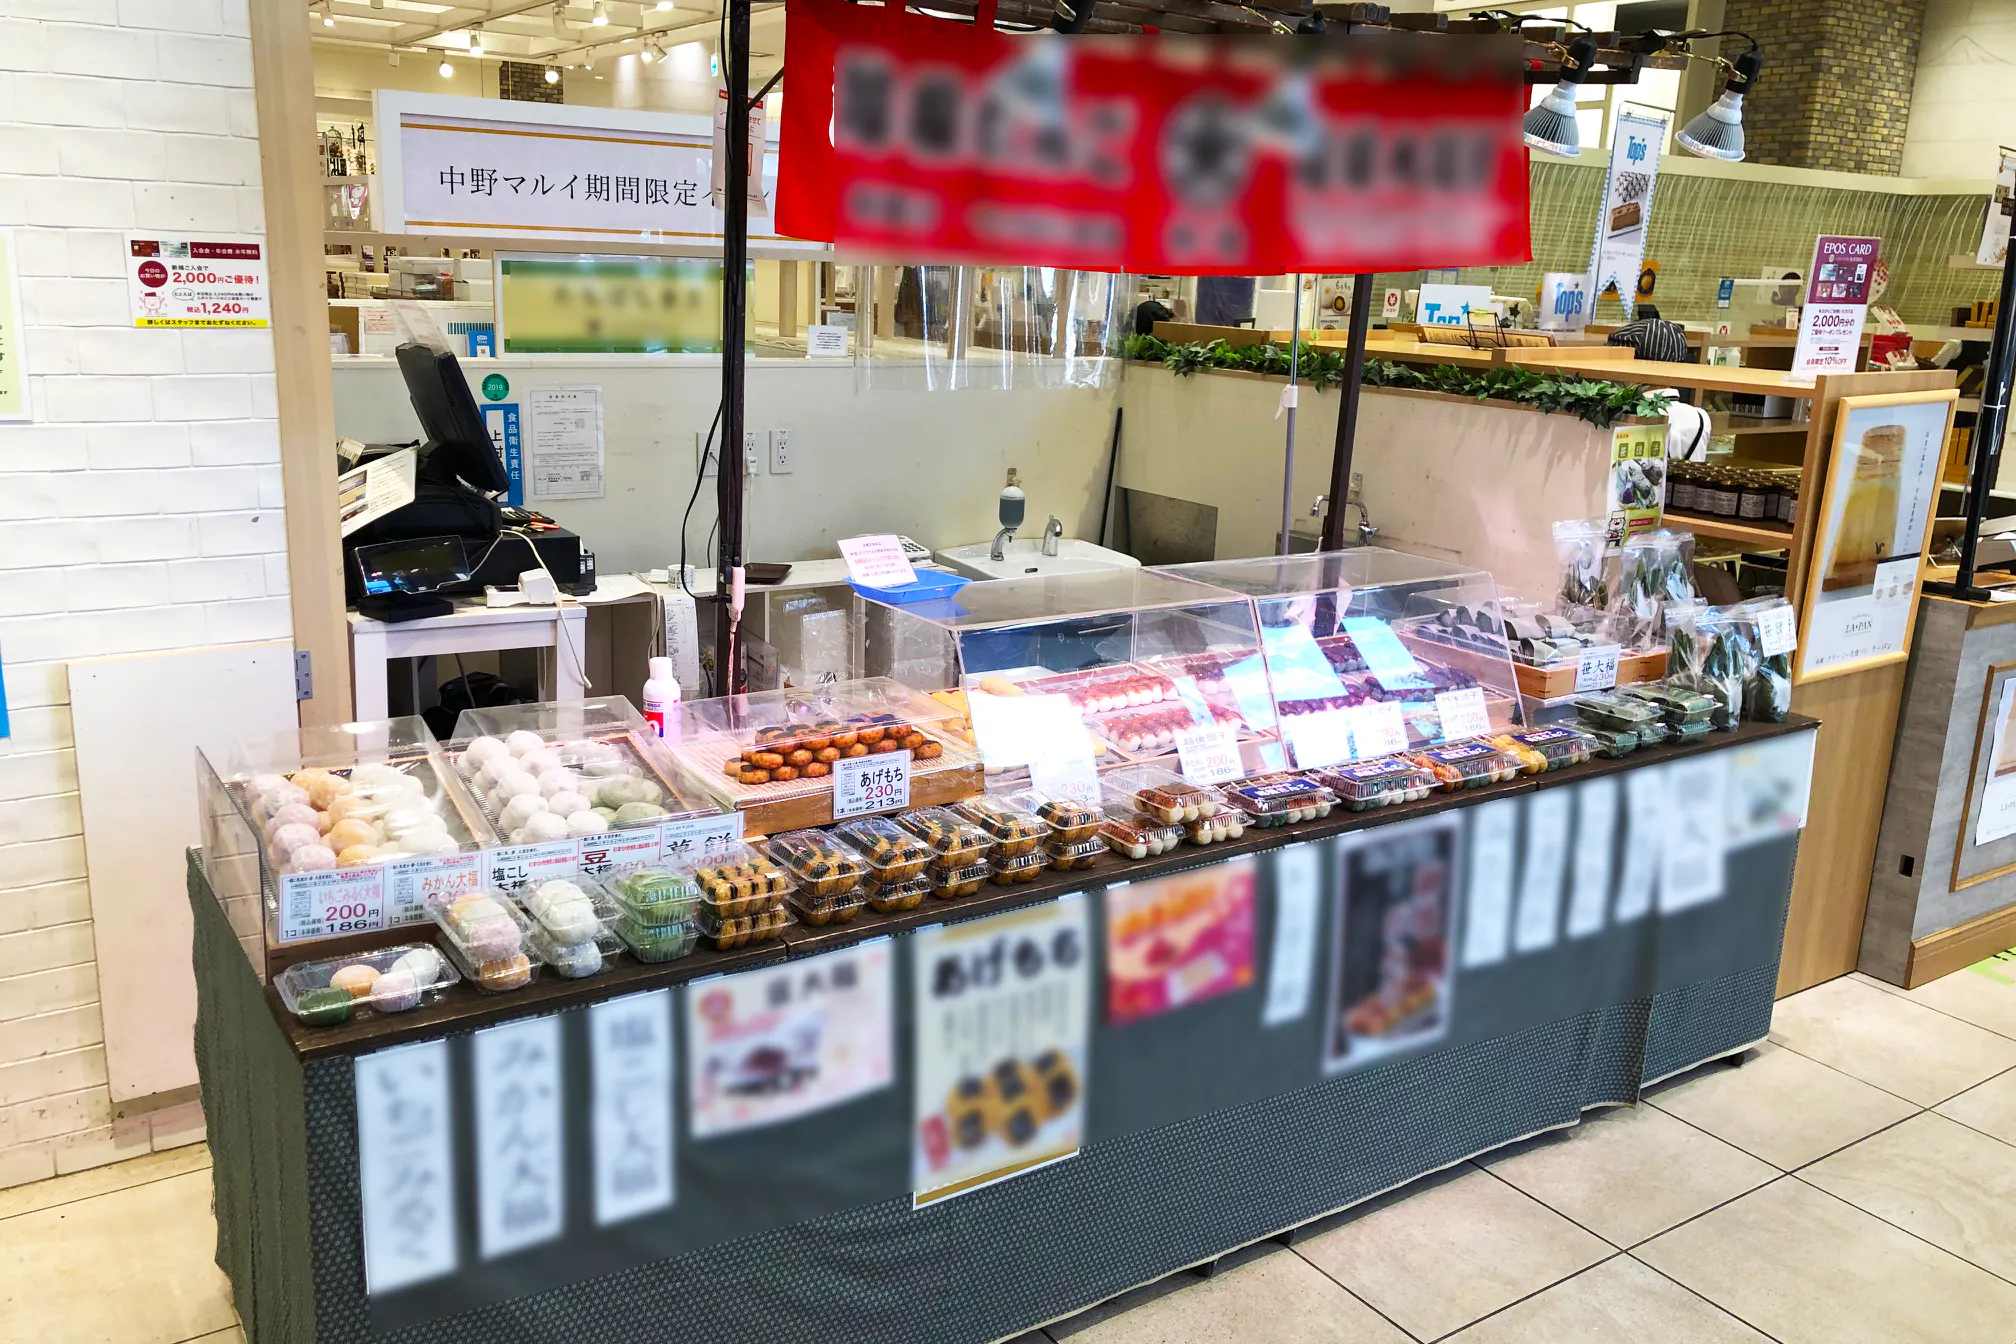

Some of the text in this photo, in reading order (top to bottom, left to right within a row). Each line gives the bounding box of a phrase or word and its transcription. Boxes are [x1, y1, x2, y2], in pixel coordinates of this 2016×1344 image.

[1824, 242, 1872, 255] EPOS CARD
[187, 302, 249, 315] 税込1,240円
[1812, 315, 1855, 327] 2,000円分の
[508, 412, 520, 480] 食品衛生責任
[1581, 658, 1615, 675] 笹大福
[1206, 754, 1236, 768] 200円
[860, 766, 903, 788] あげもち
[865, 784, 902, 800] 230円
[865, 797, 903, 810] 213円
[579, 849, 612, 865] 豆
[421, 870, 479, 892] みかん大福
[492, 865, 528, 882] 塩こし
[318, 884, 381, 904] いちごみるく大福
[325, 903, 379, 922] 200円
[325, 919, 379, 933] 186円
